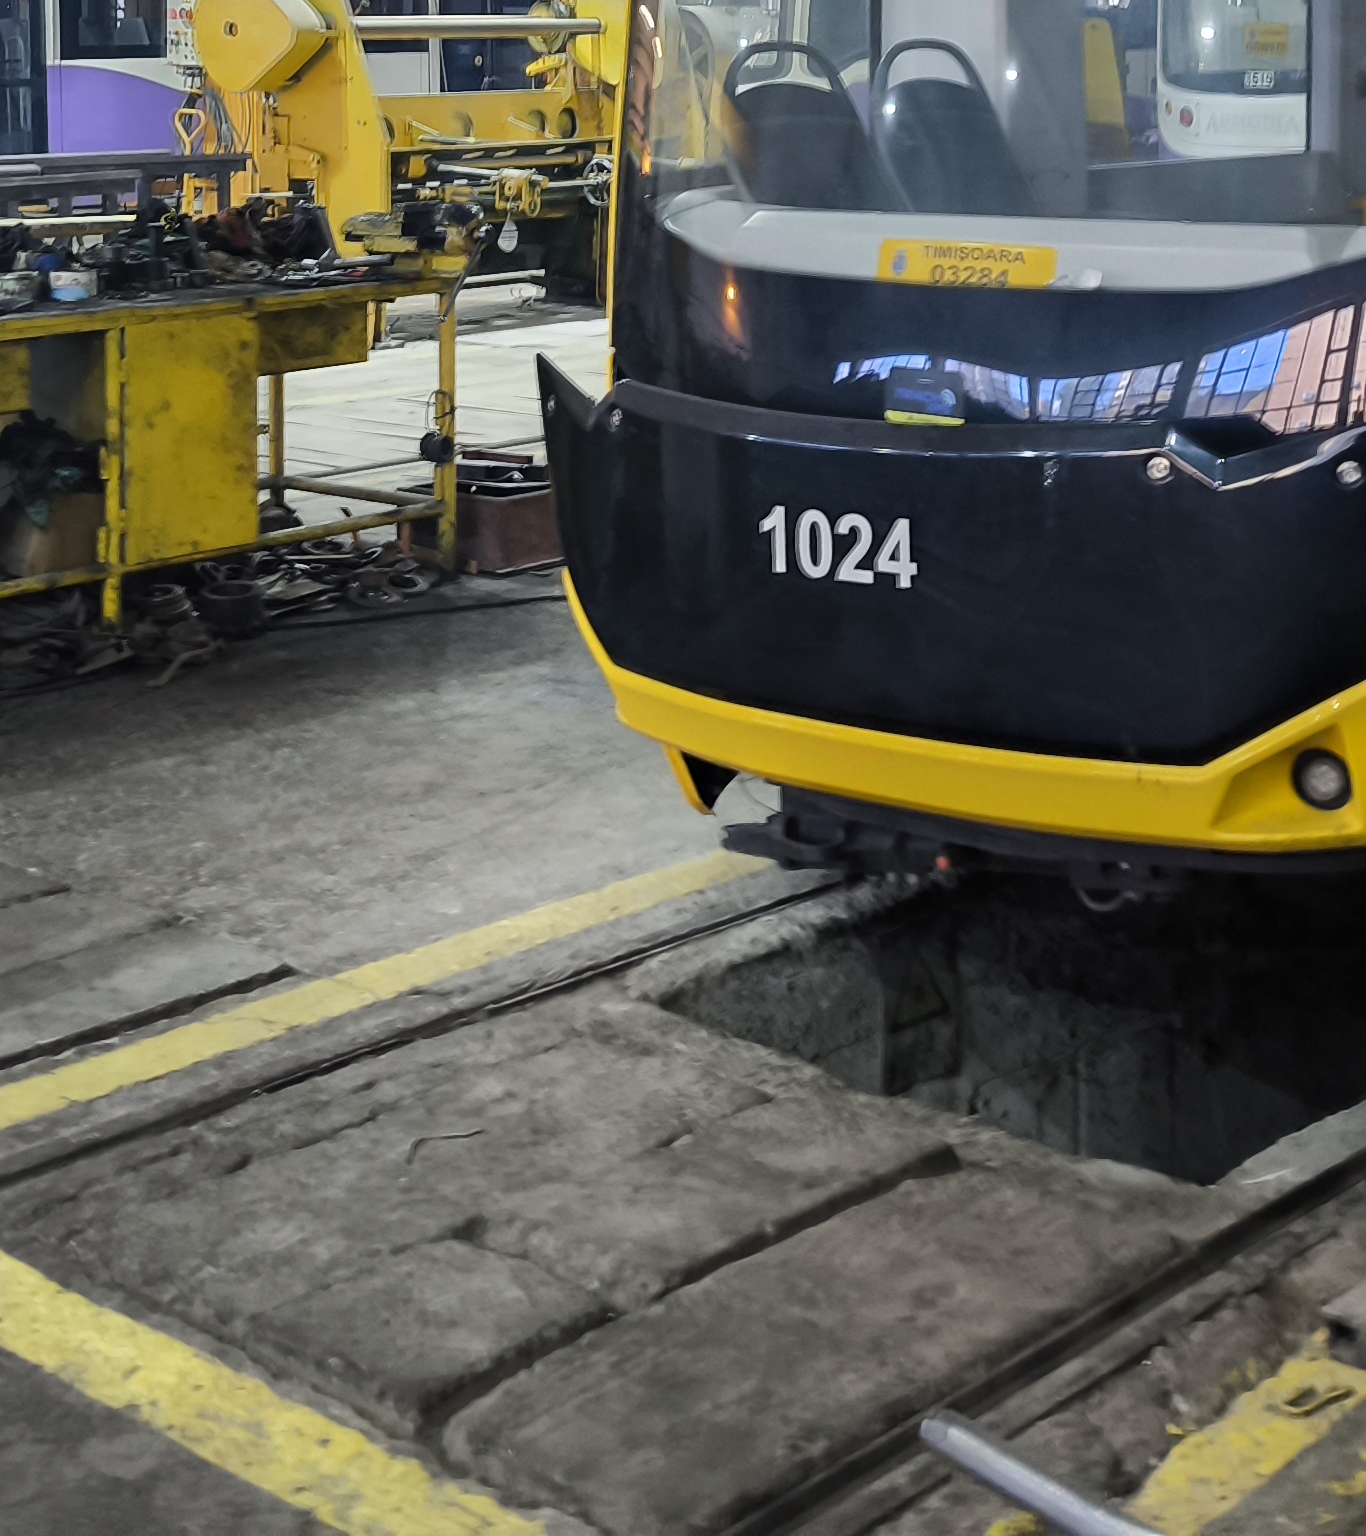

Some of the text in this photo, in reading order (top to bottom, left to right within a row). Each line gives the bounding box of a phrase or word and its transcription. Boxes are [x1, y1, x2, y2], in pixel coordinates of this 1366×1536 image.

[923, 245, 1026, 265] TIMIȘOARA
[932, 263, 1011, 287] 03284
[758, 504, 918, 589] 1024
